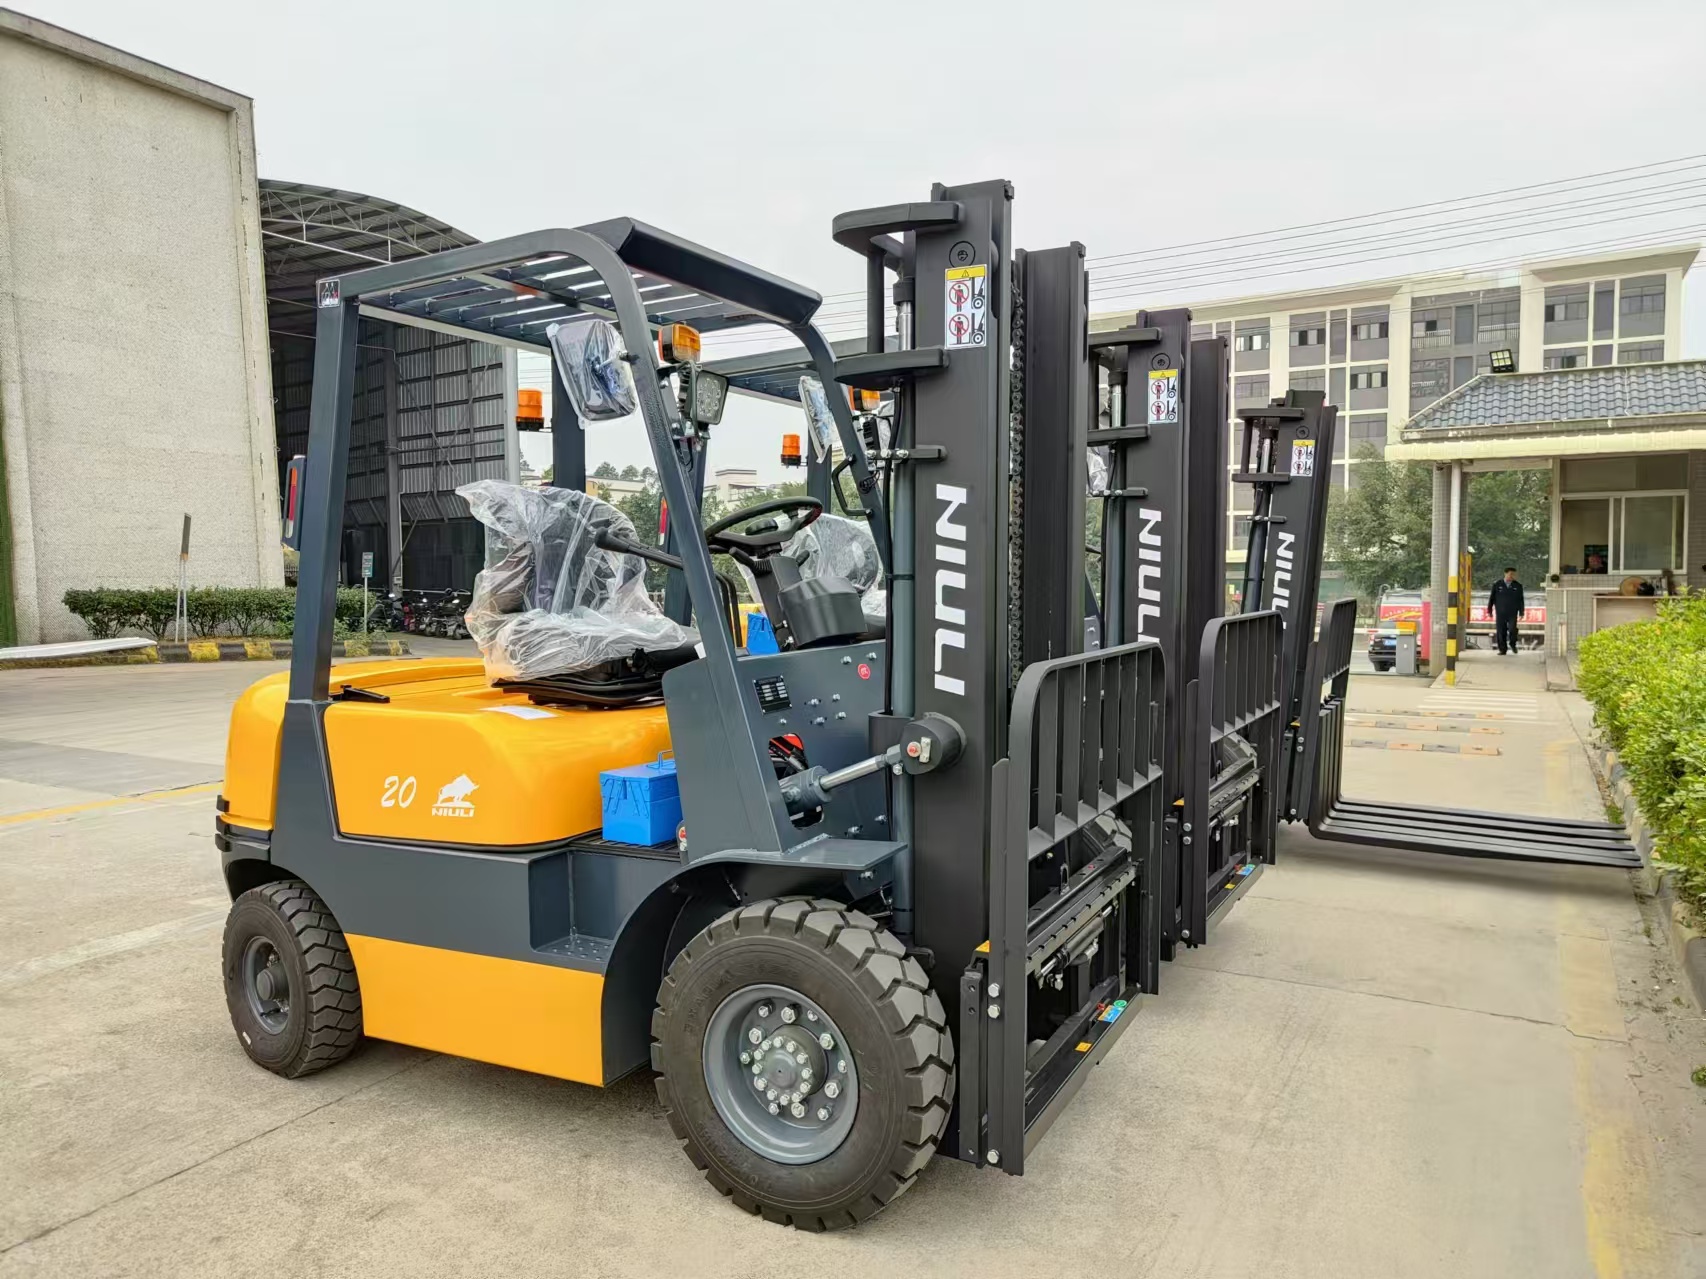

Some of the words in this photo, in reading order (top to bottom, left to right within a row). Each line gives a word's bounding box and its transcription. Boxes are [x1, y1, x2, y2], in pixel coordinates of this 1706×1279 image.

[934, 483, 967, 697] NIULI
[1271, 531, 1296, 630] NIUL
[380, 775, 417, 809] 20
[431, 807, 475, 817] NIULI
